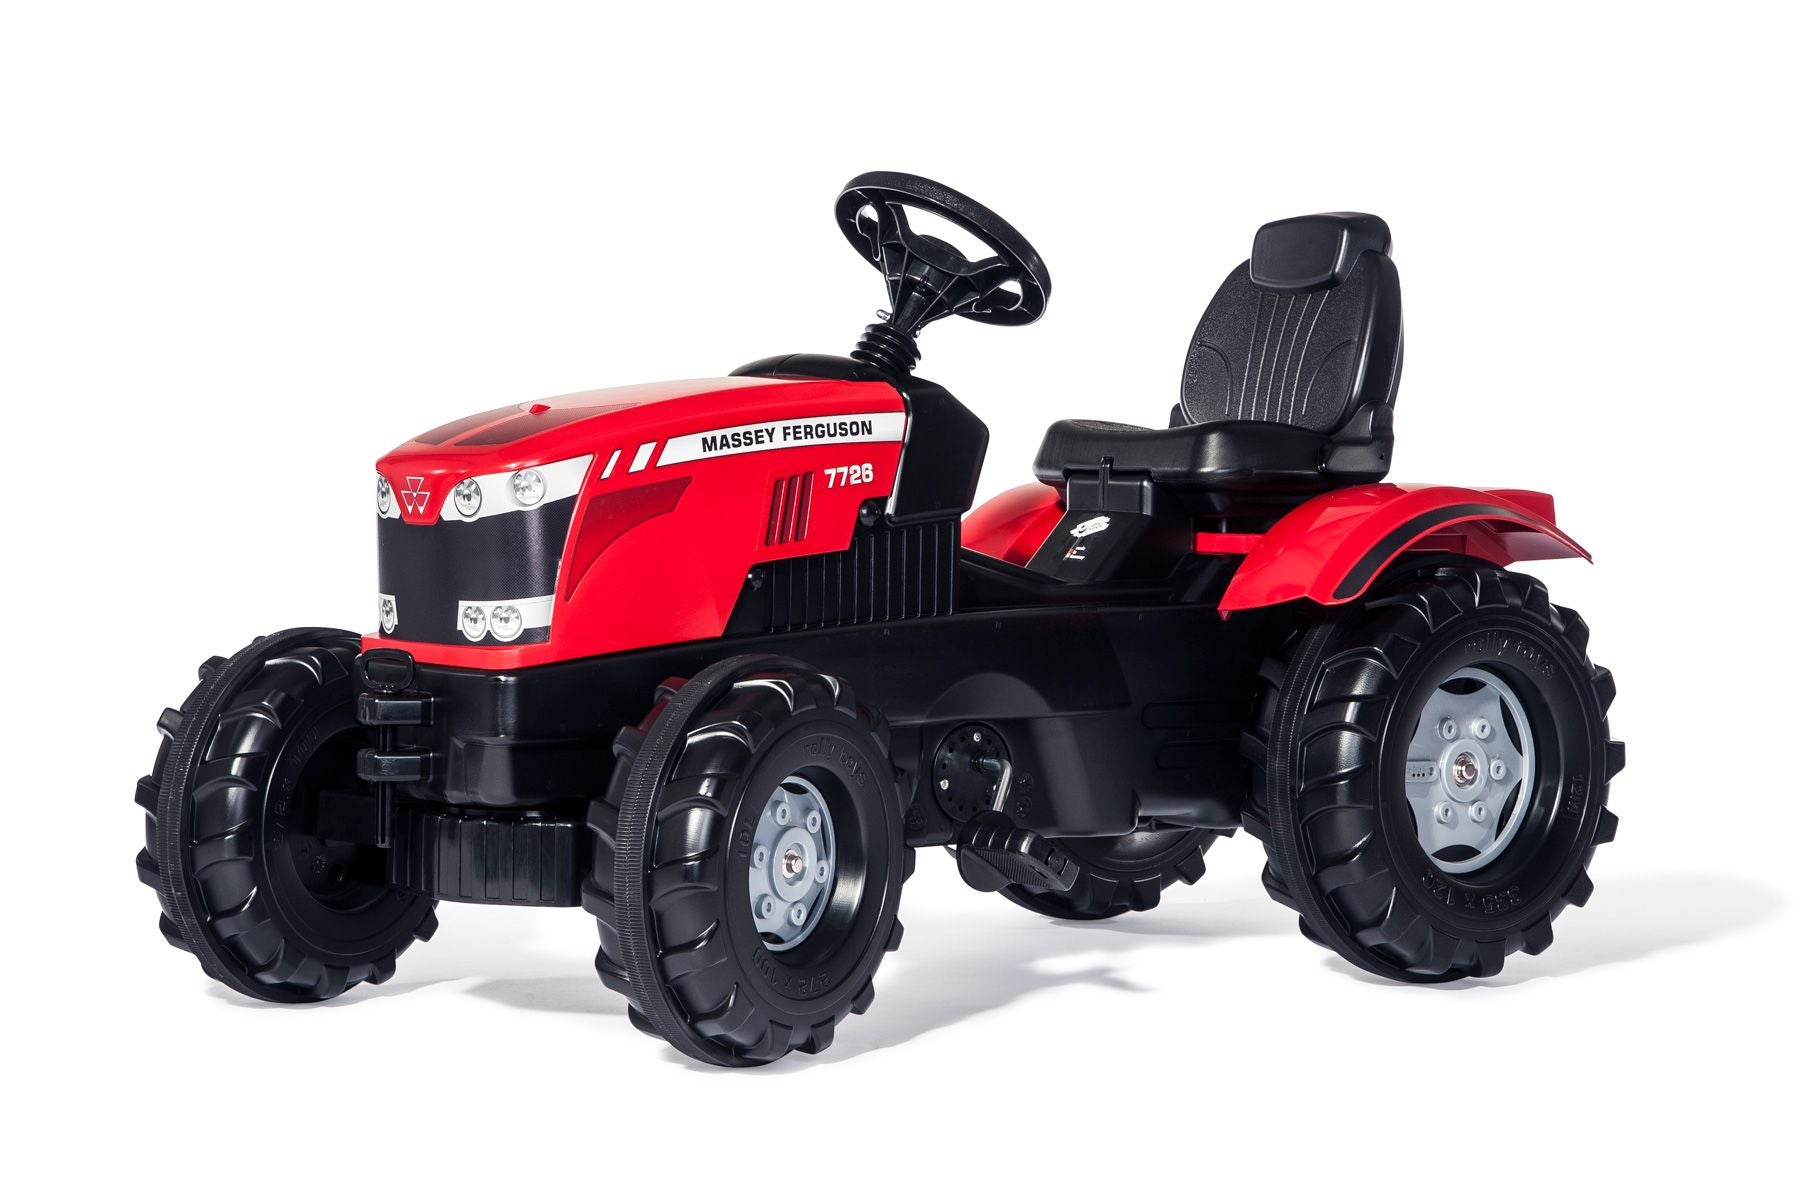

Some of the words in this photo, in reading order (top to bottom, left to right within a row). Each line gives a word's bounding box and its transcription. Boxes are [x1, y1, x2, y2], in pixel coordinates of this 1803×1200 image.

[702, 427, 776, 452] MASSEY
[783, 420, 873, 441] FERGUSON
[823, 463, 873, 488] 7726
